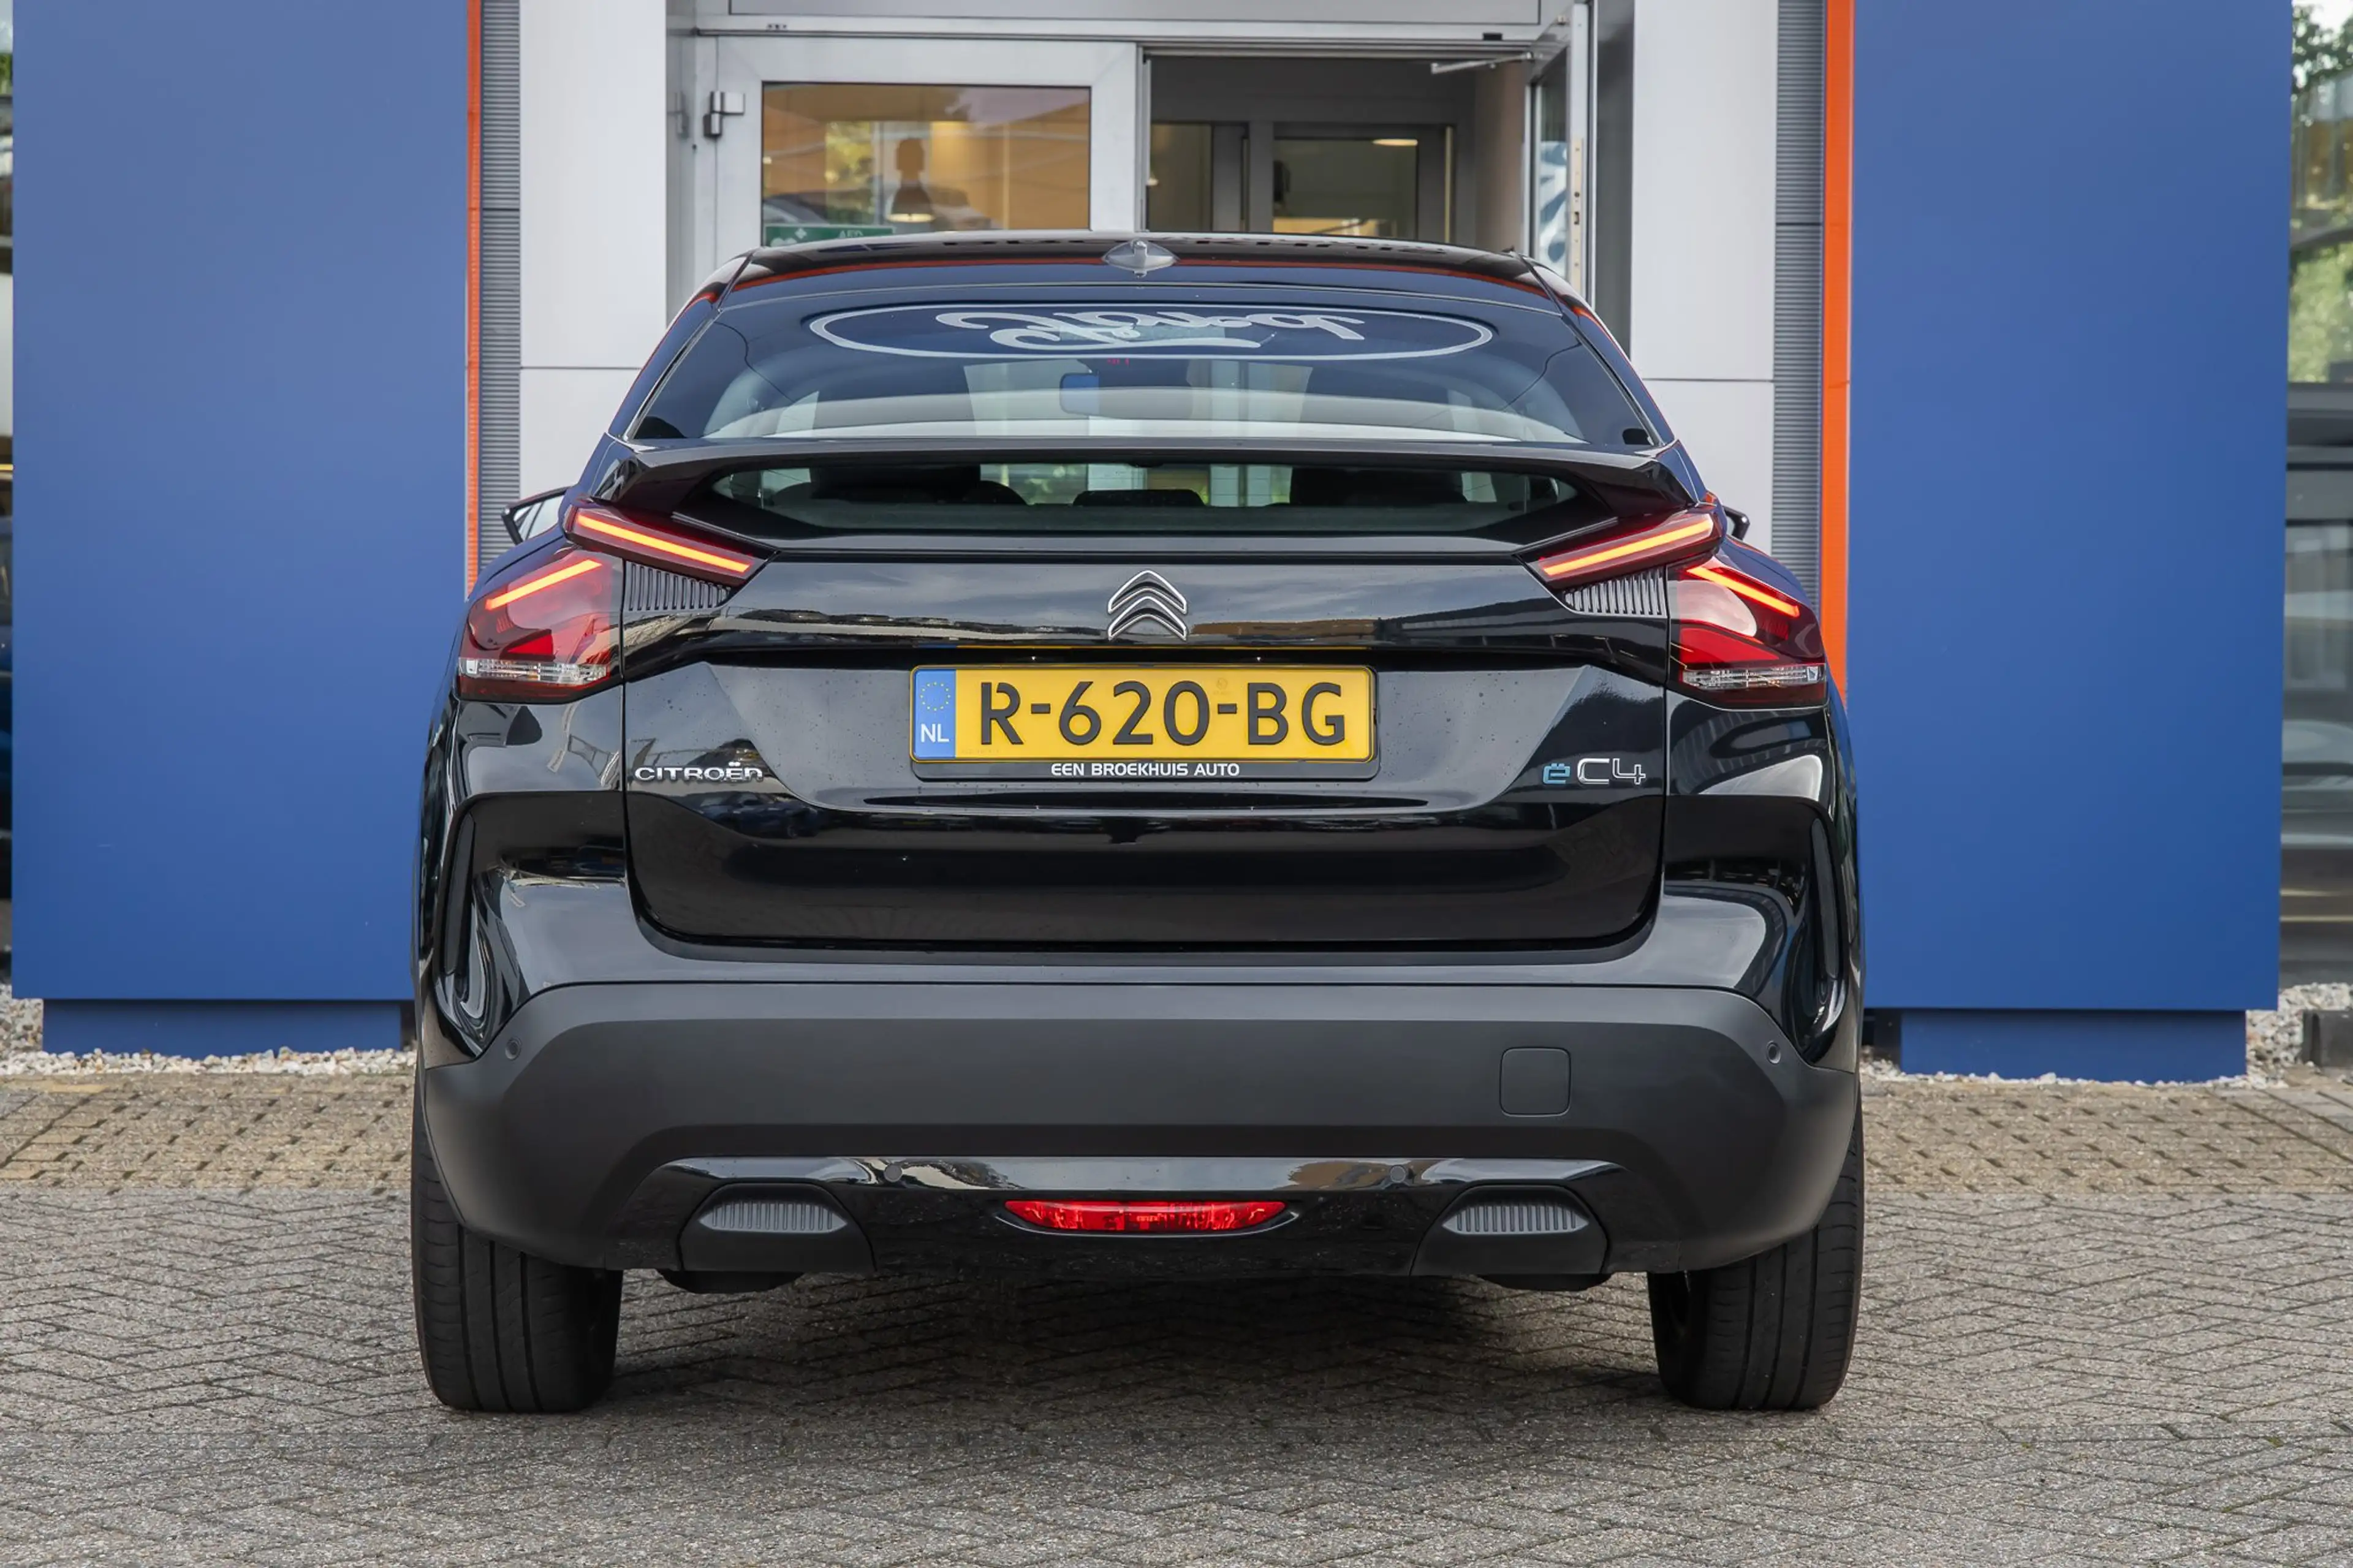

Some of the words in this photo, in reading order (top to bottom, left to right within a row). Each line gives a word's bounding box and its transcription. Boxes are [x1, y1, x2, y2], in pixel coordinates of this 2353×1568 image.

[981, 681, 1345, 746] R-620-BG
[920, 724, 949, 742] NL
[1051, 763, 1084, 776] EEN
[1091, 763, 1189, 776] BROEKHUIS
[1194, 763, 1240, 776] AUTO
